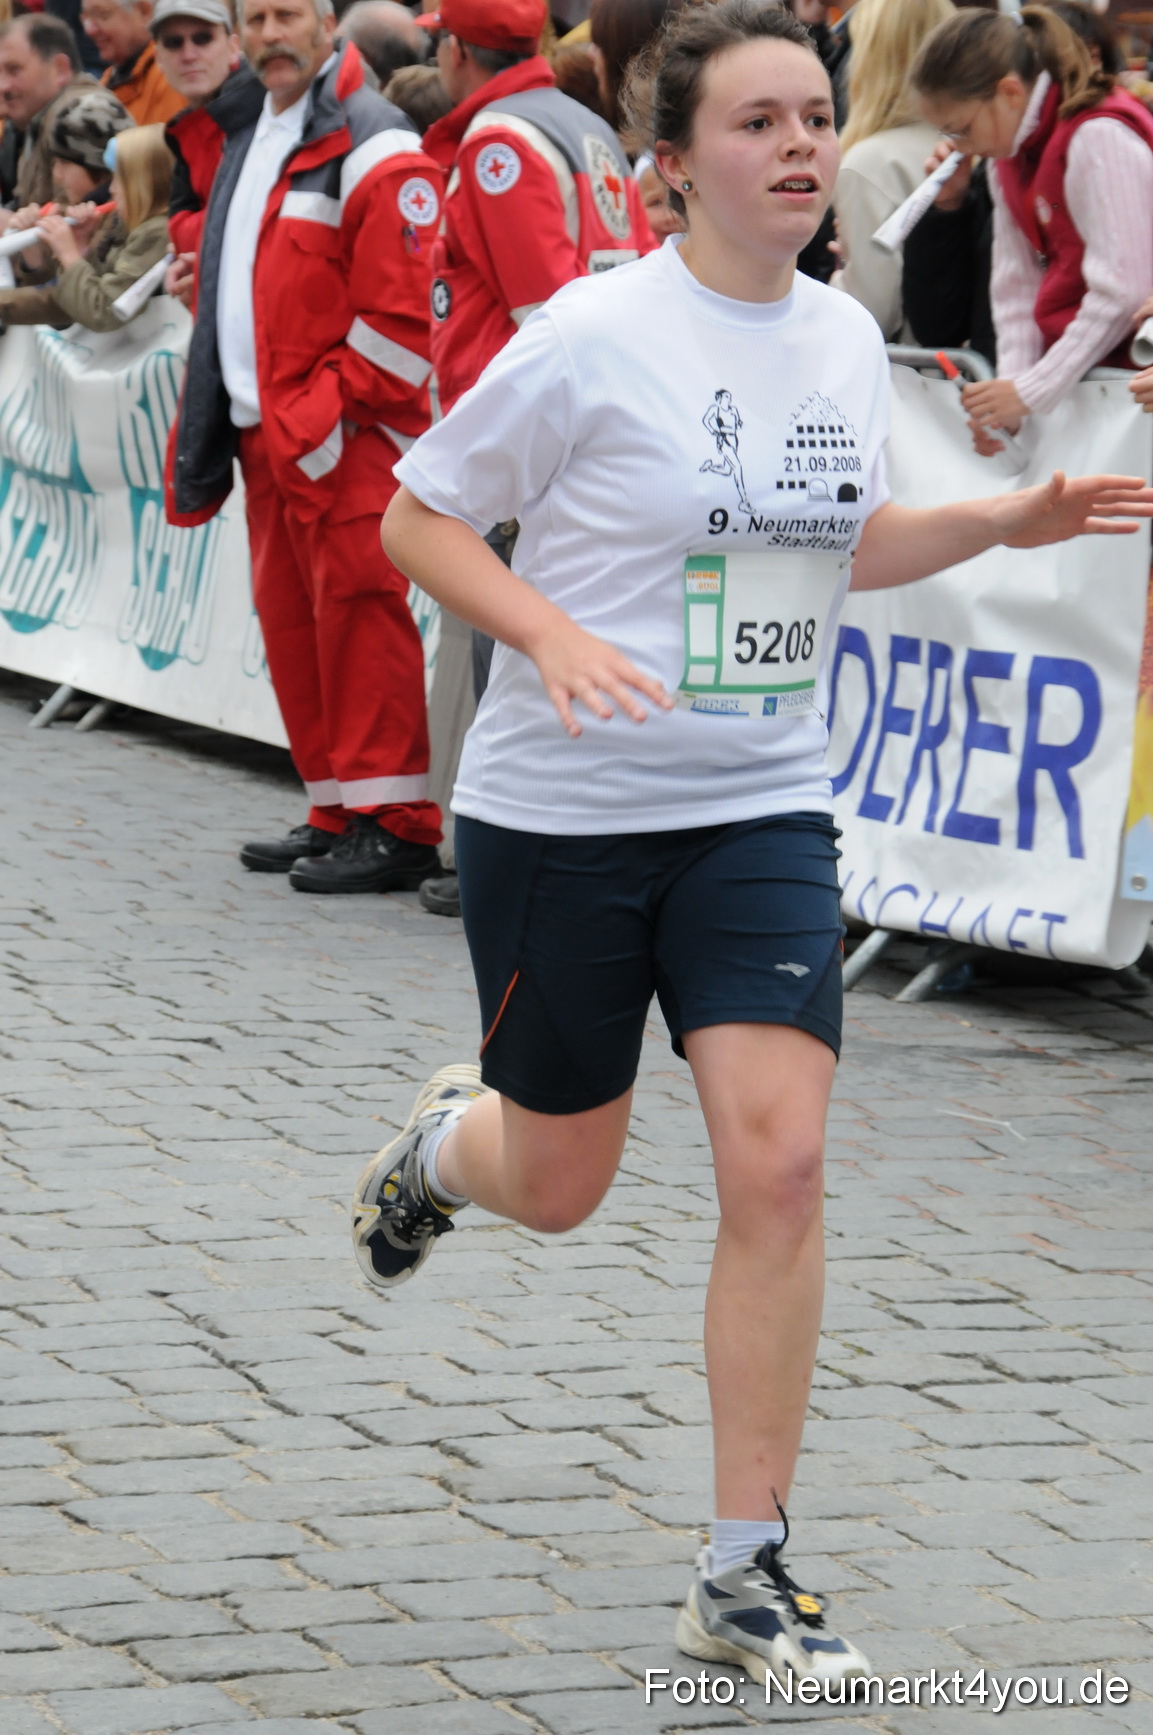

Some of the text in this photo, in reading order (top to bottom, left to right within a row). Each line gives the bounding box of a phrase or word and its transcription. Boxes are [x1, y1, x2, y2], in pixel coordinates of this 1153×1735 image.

[784, 456, 862, 473] 21.09.2008
[707, 508, 860, 535] 9. Neumarkter
[734, 618, 816, 664] 5208
